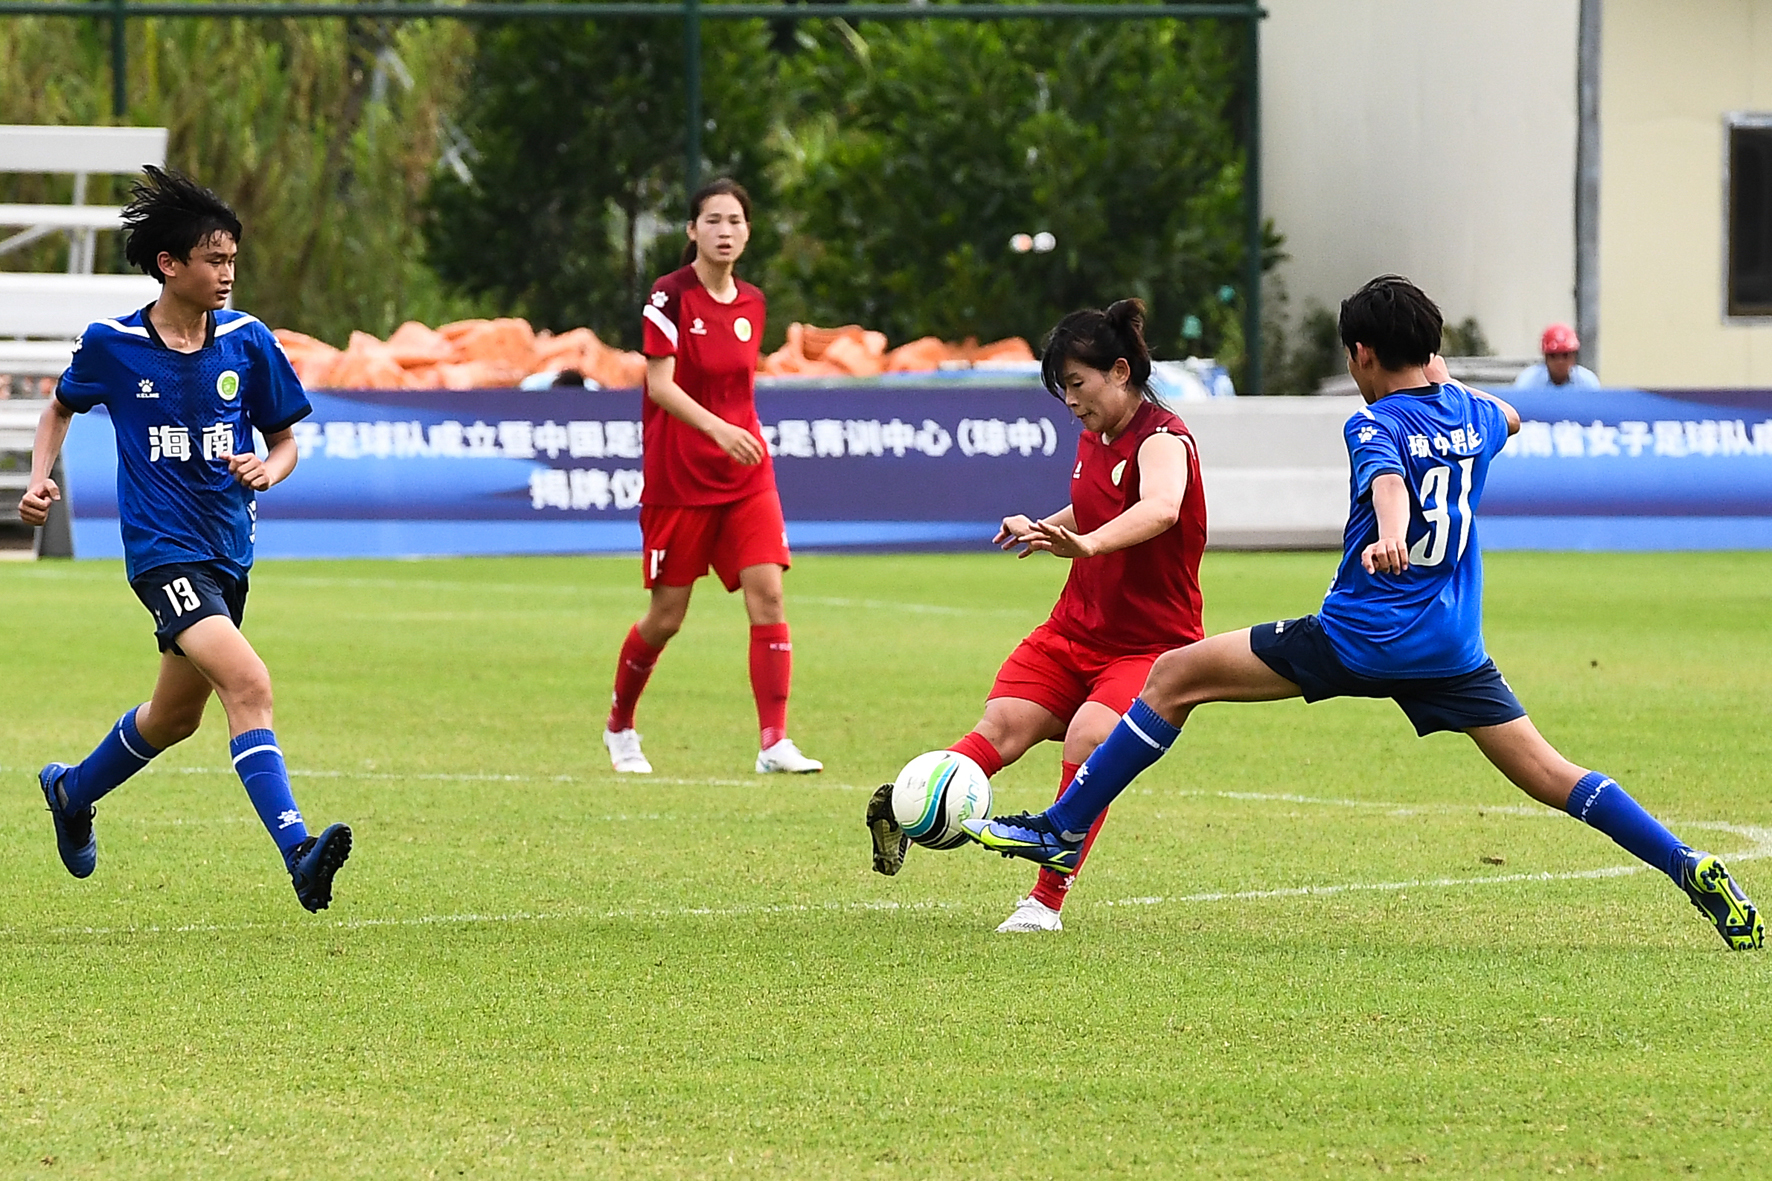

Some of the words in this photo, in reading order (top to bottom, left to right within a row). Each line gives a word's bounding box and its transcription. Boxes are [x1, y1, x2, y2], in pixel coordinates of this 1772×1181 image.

[148, 422, 234, 462] 海南
[293, 420, 644, 459] 子足球队成立暨中国足
[1407, 423, 1482, 458] 琼中男足
[1409, 457, 1475, 567] 31
[161, 577, 201, 617] 13
